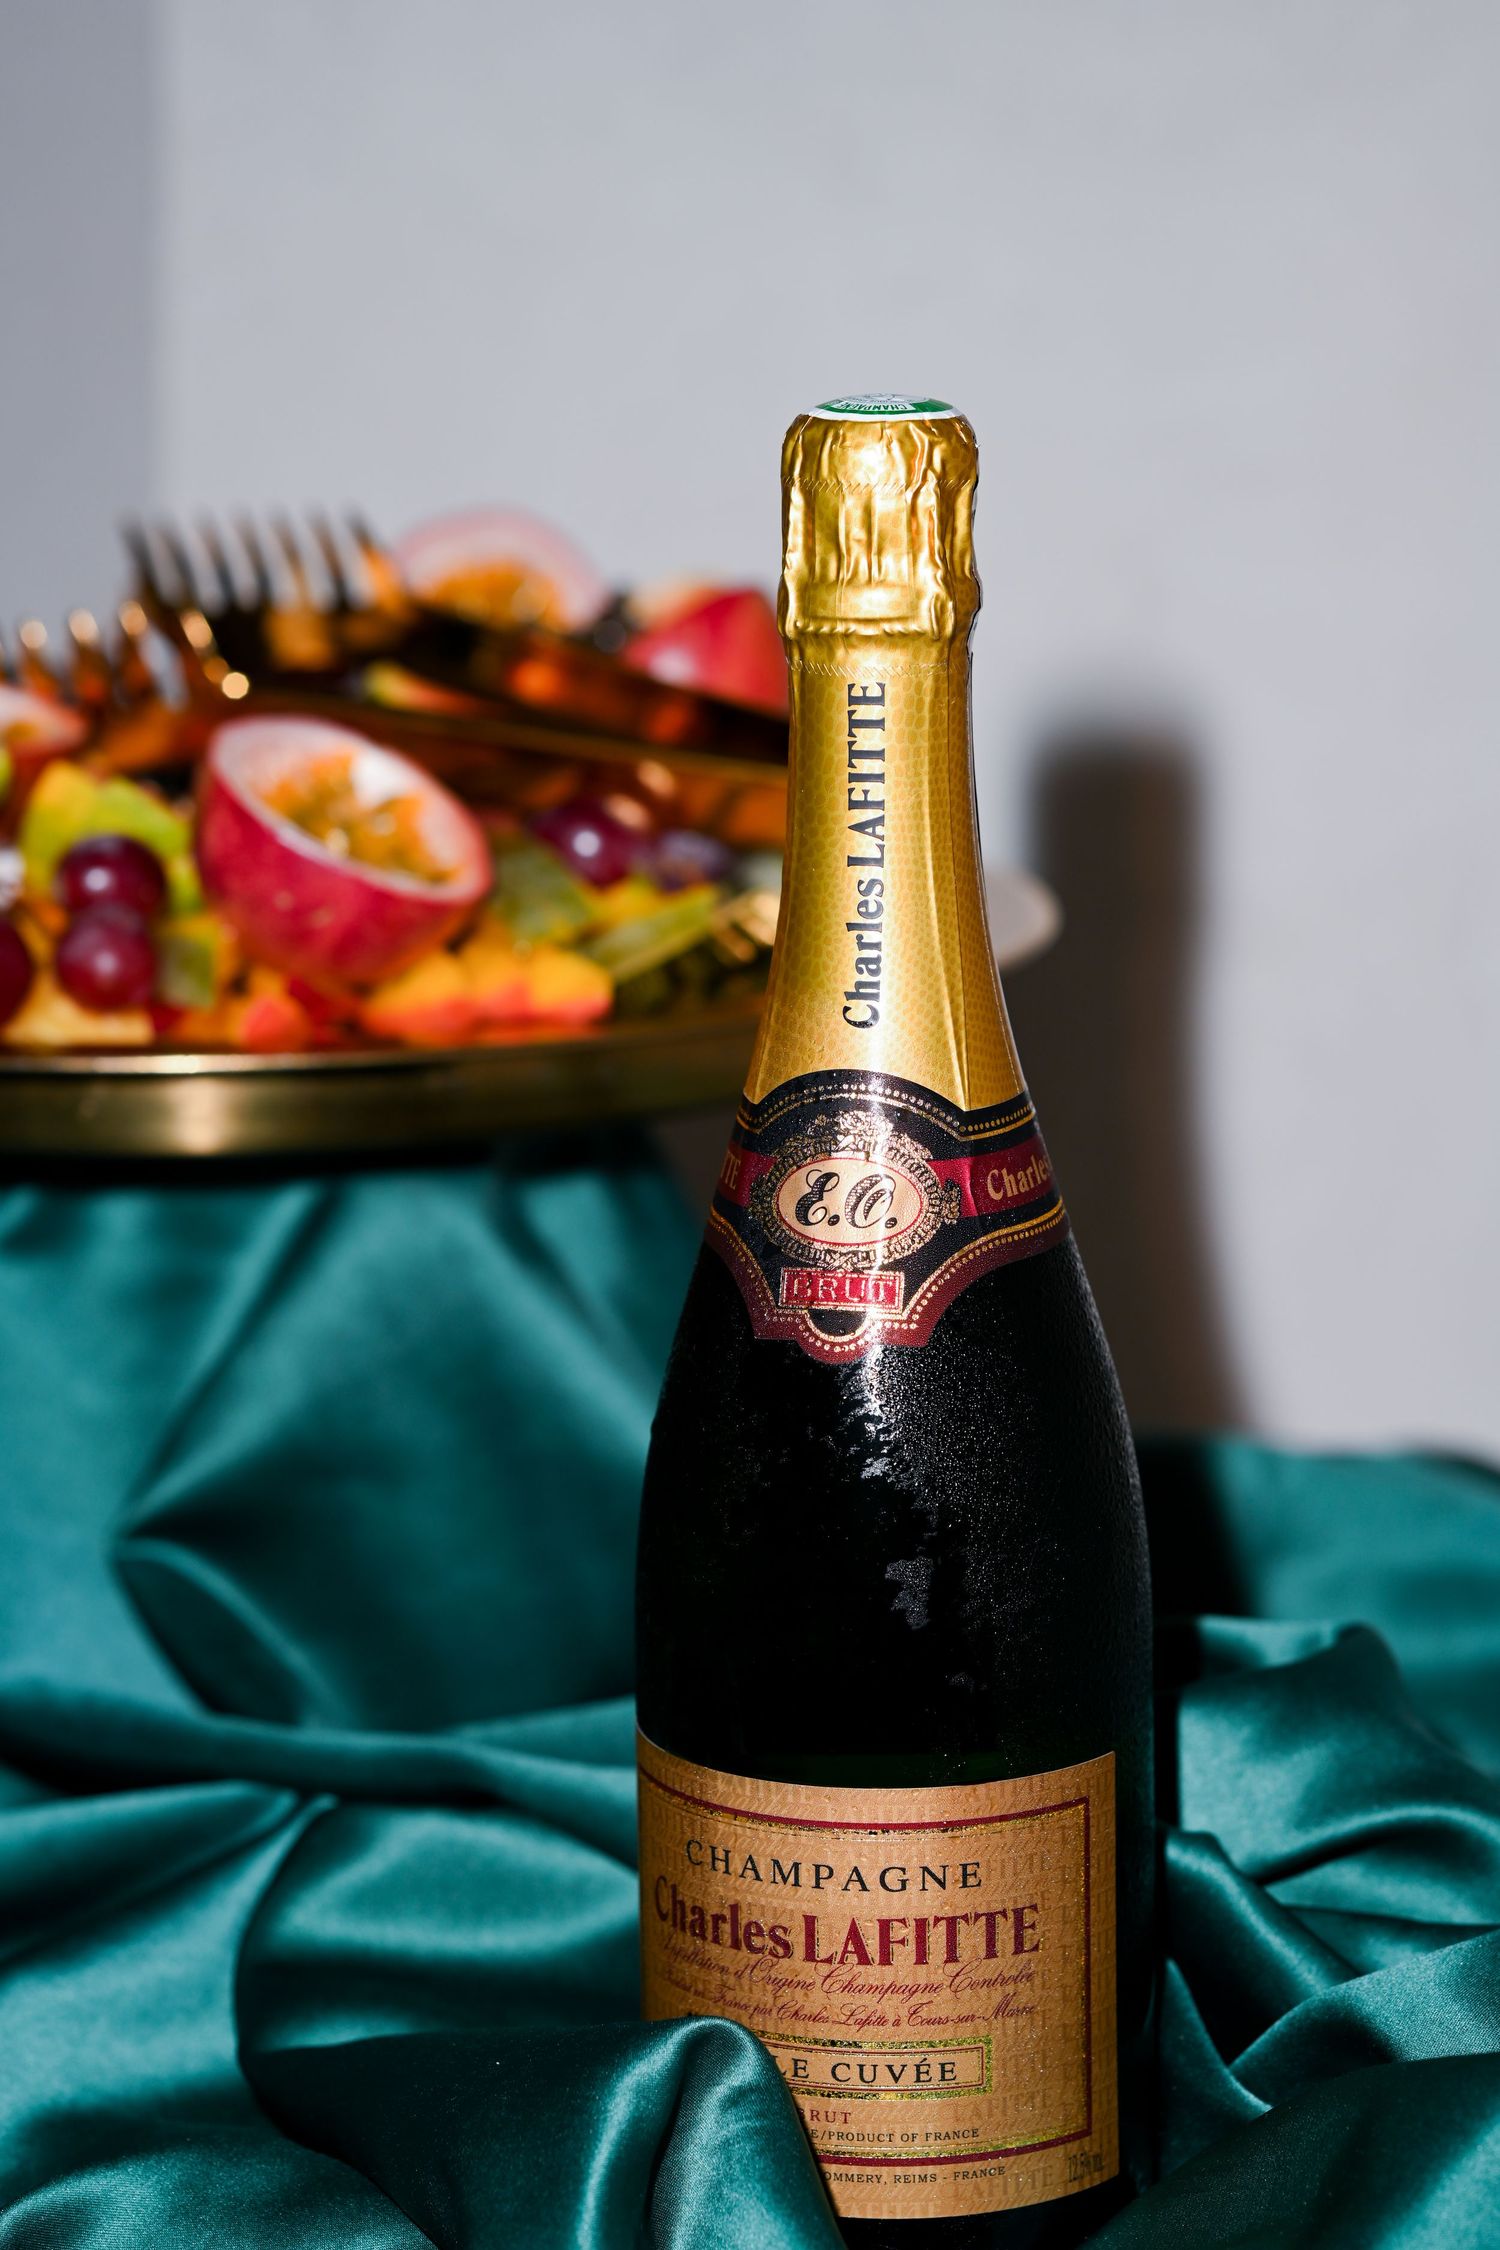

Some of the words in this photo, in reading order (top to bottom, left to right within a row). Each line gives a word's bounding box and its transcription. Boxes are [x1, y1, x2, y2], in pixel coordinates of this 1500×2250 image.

[840, 402, 908, 411] CHAMPAGNE
[847, 681, 886, 868] LAFITTE
[842, 878, 884, 1029] Charles
[988, 1154, 1050, 1200] Charle
[794, 1276, 894, 1302] BRUT
[686, 1839, 982, 1893] CHAMPAGNE
[655, 1875, 794, 1960] Charles
[802, 1904, 1040, 1966] LAFITTE
[814, 1963, 944, 2004] Champagne
[773, 1995, 830, 2024] Charles
[832, 2003, 888, 2032] Lafitte
[831, 2058, 957, 2084] CUVÉE
[901, 2133, 918, 2142] OF
[925, 2129, 979, 2141] FRANCE
[894, 2174, 937, 2184] REIMS
[954, 2166, 1006, 2181] FRANCE
